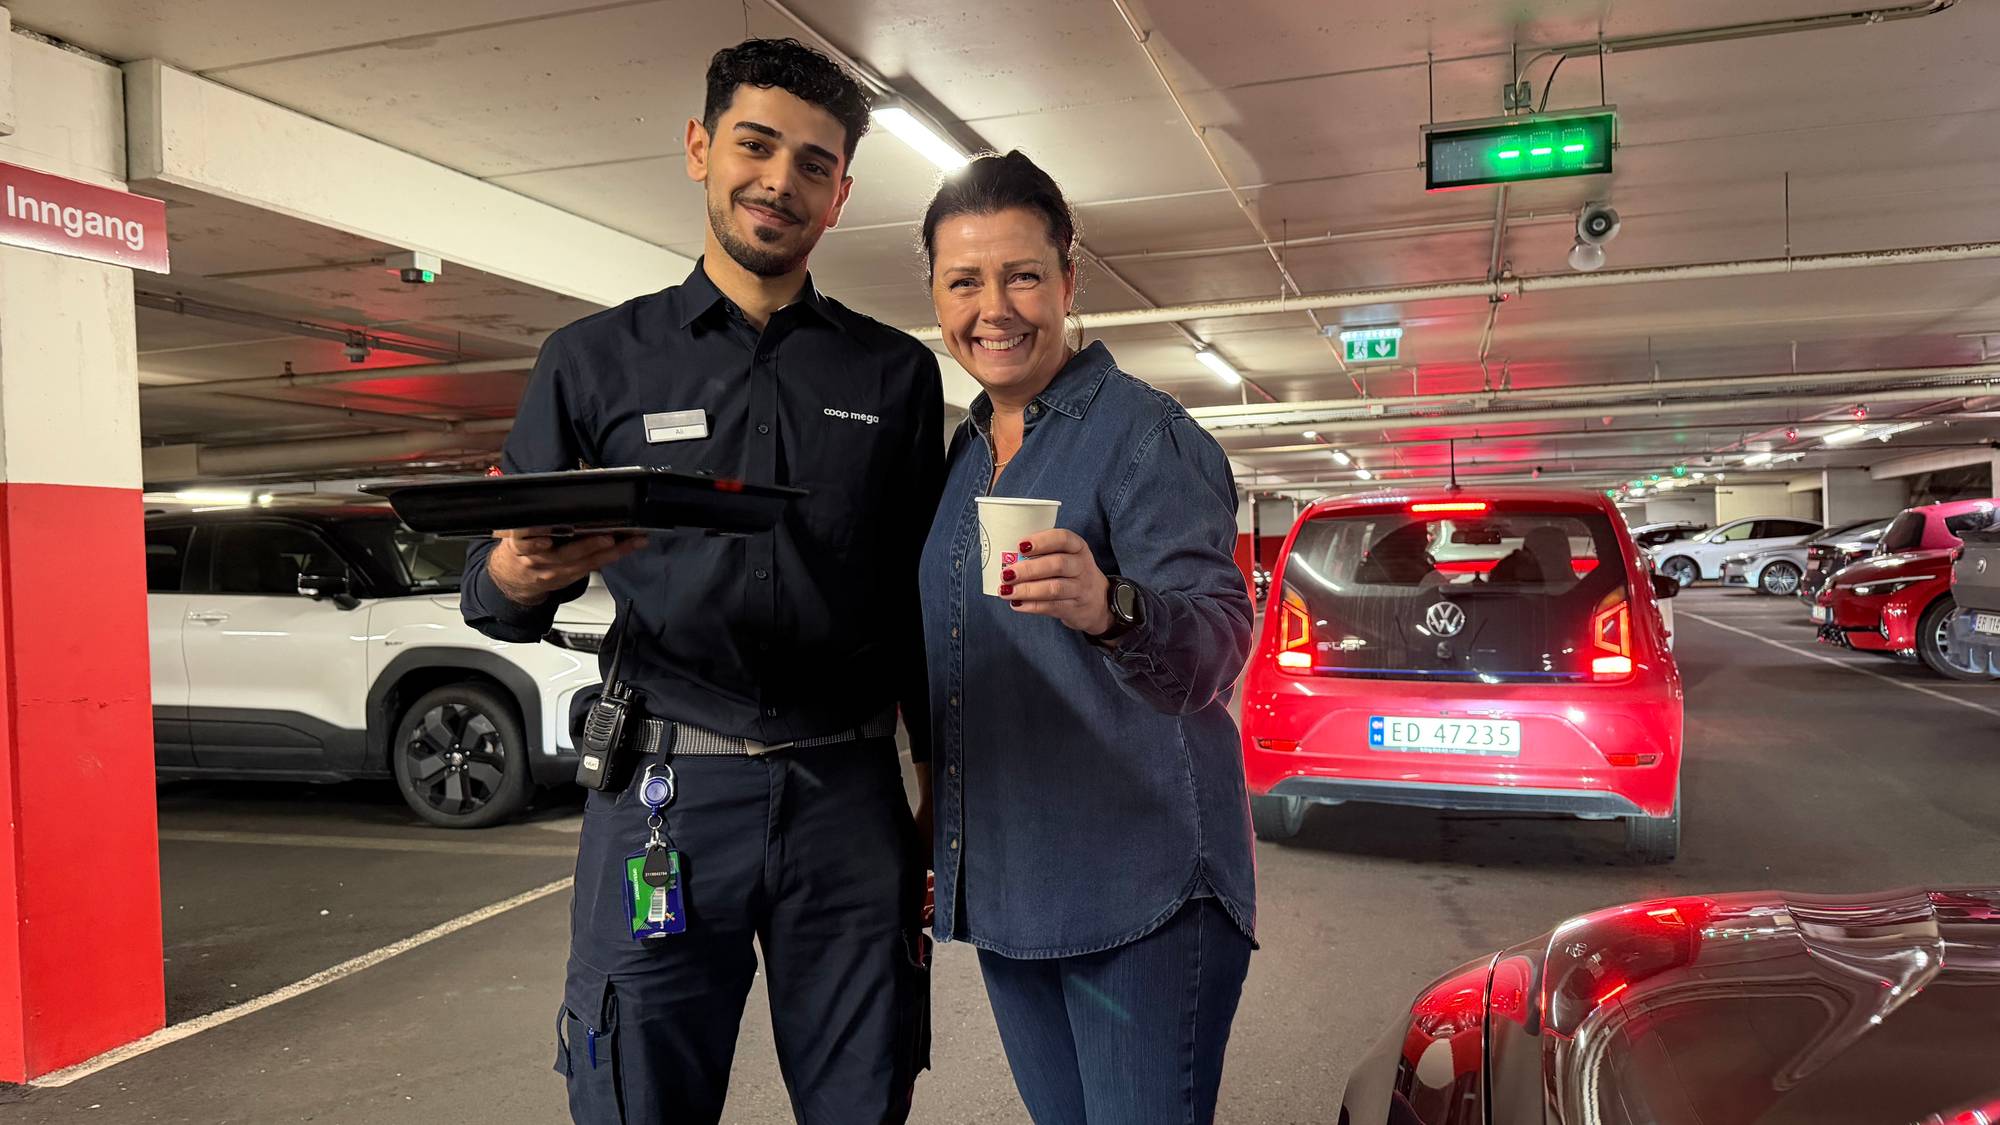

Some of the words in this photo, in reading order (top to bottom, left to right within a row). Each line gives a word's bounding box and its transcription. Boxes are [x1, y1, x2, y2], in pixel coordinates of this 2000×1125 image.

[7, 184, 145, 250] Inngang
[823, 408, 849, 419] coop
[850, 412, 880, 424] mega
[1392, 722, 1421, 743] ED
[1433, 723, 1511, 746] 47235
